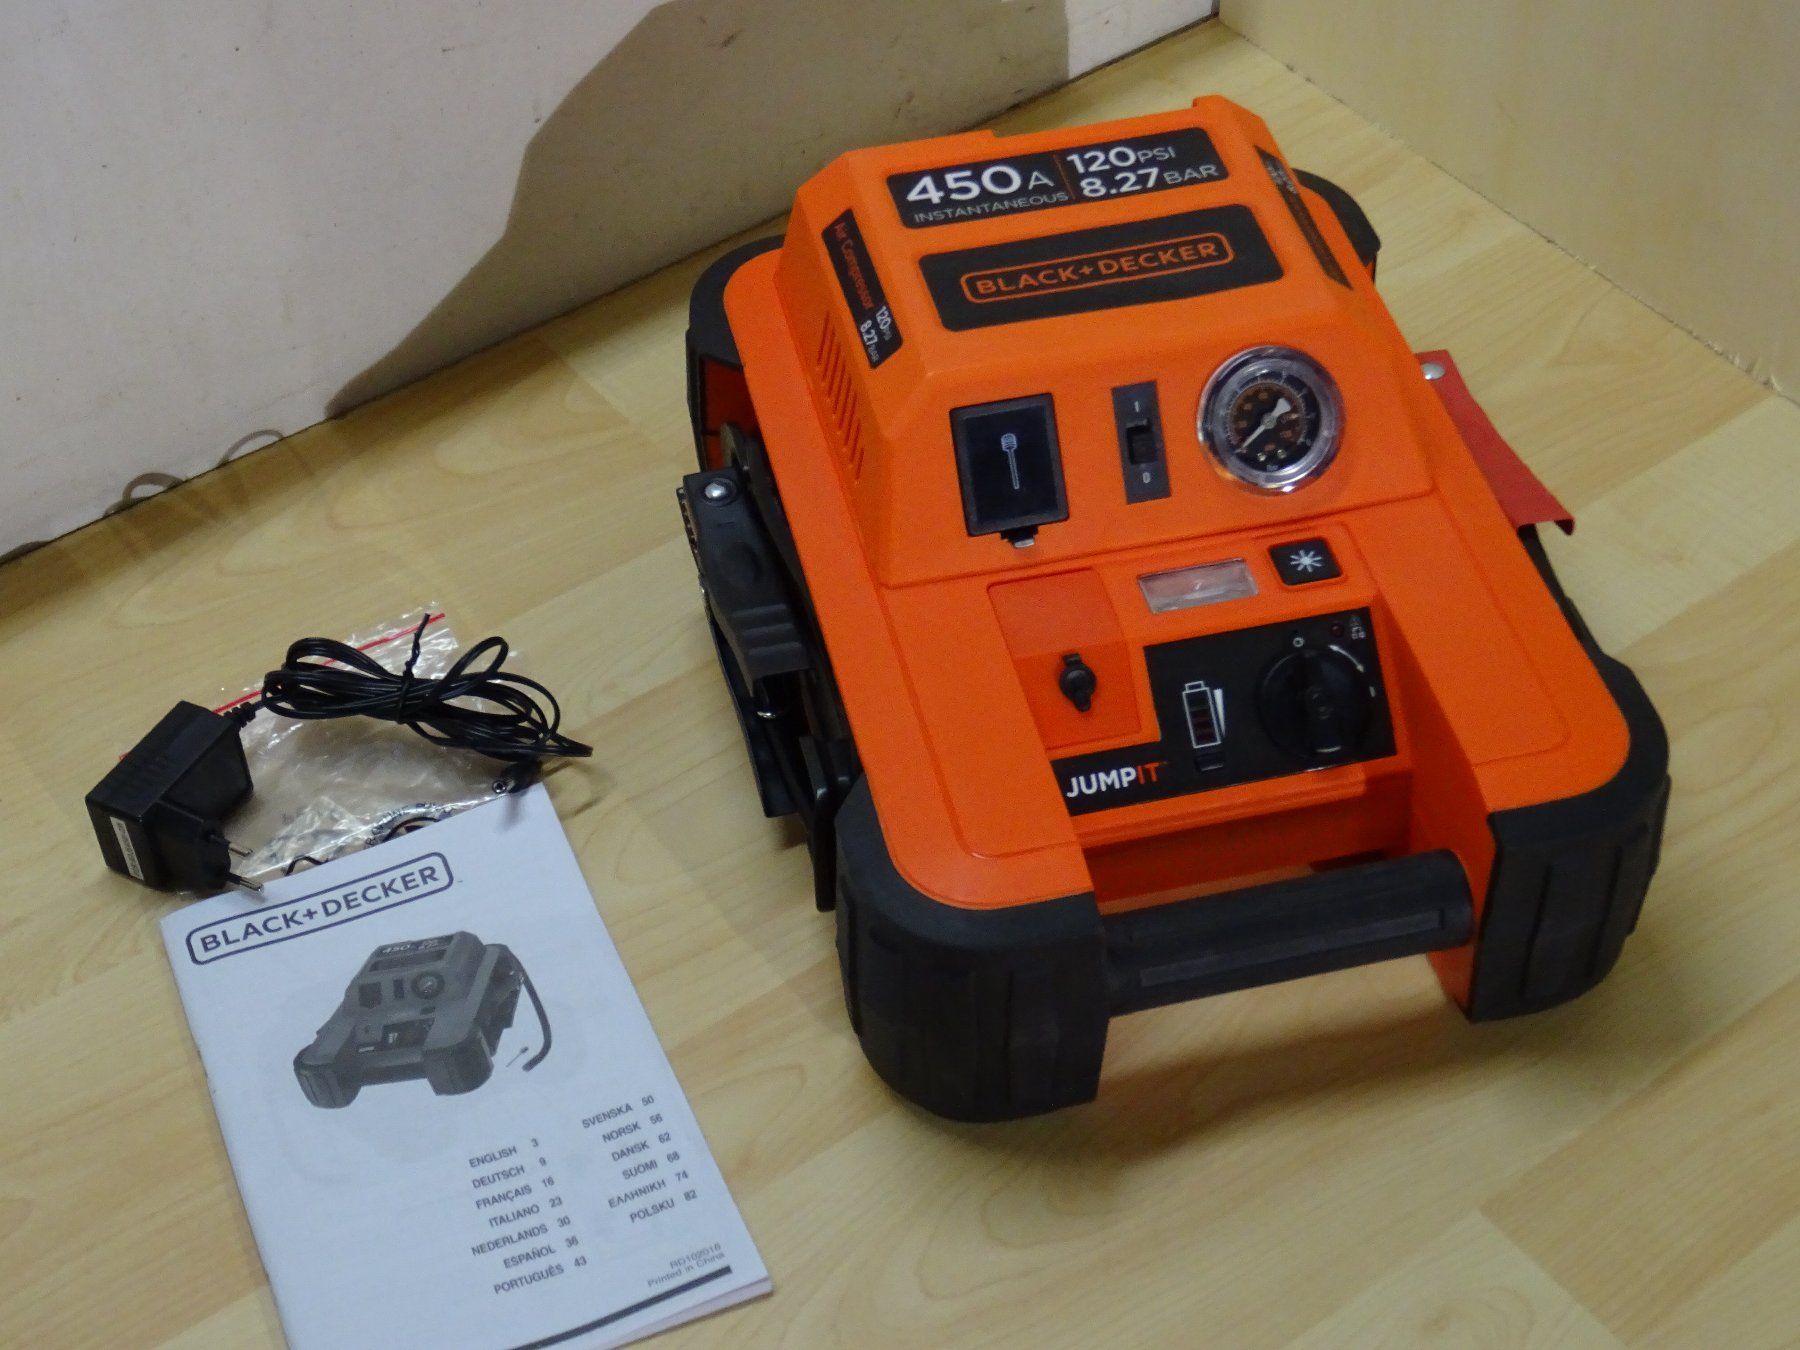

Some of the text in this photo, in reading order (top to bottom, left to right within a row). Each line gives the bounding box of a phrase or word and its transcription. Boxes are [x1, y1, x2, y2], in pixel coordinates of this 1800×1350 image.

[914, 192, 1069, 223] INSTANTANEOUS
[976, 242, 1218, 295] BLACK+DECKER
[200, 865, 440, 953] BLACK+DECKER
[582, 1095, 655, 1128] SVENSKA 50
[602, 1113, 663, 1143] NORSK 56
[469, 1138, 539, 1168] ENGLISH 3
[611, 1131, 671, 1162] DANSK 62
[472, 1165, 525, 1189] DEUTSCH
[622, 1160, 658, 1180] SUOMI
[674, 1169, 689, 1182] 74
[475, 1184, 532, 1210] FRANÇAIS
[488, 1196, 562, 1228] ITALIANO 23
[471, 1215, 571, 1256] NEDERLANDS 30
[503, 1244, 556, 1269] ESPAÑOL
[574, 1255, 587, 1267] 43
[647, 1268, 682, 1287] Printed
